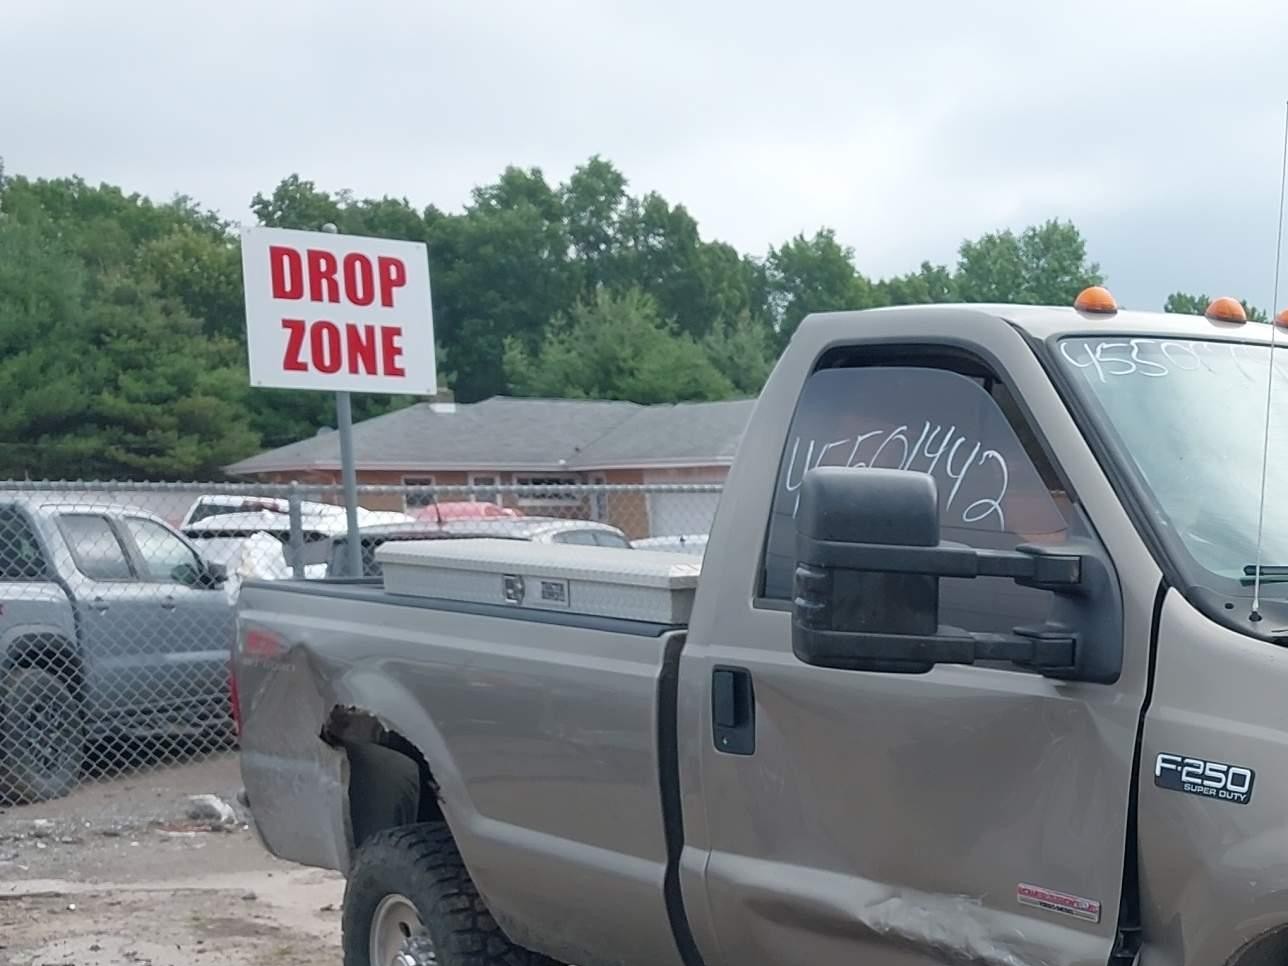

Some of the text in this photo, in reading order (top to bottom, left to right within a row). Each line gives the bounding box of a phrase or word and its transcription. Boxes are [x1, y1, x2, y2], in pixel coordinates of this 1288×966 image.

[269, 245, 407, 308] DROP
[281, 318, 406, 377] ZONE
[1184, 783, 1247, 801] SUPER DUTY
